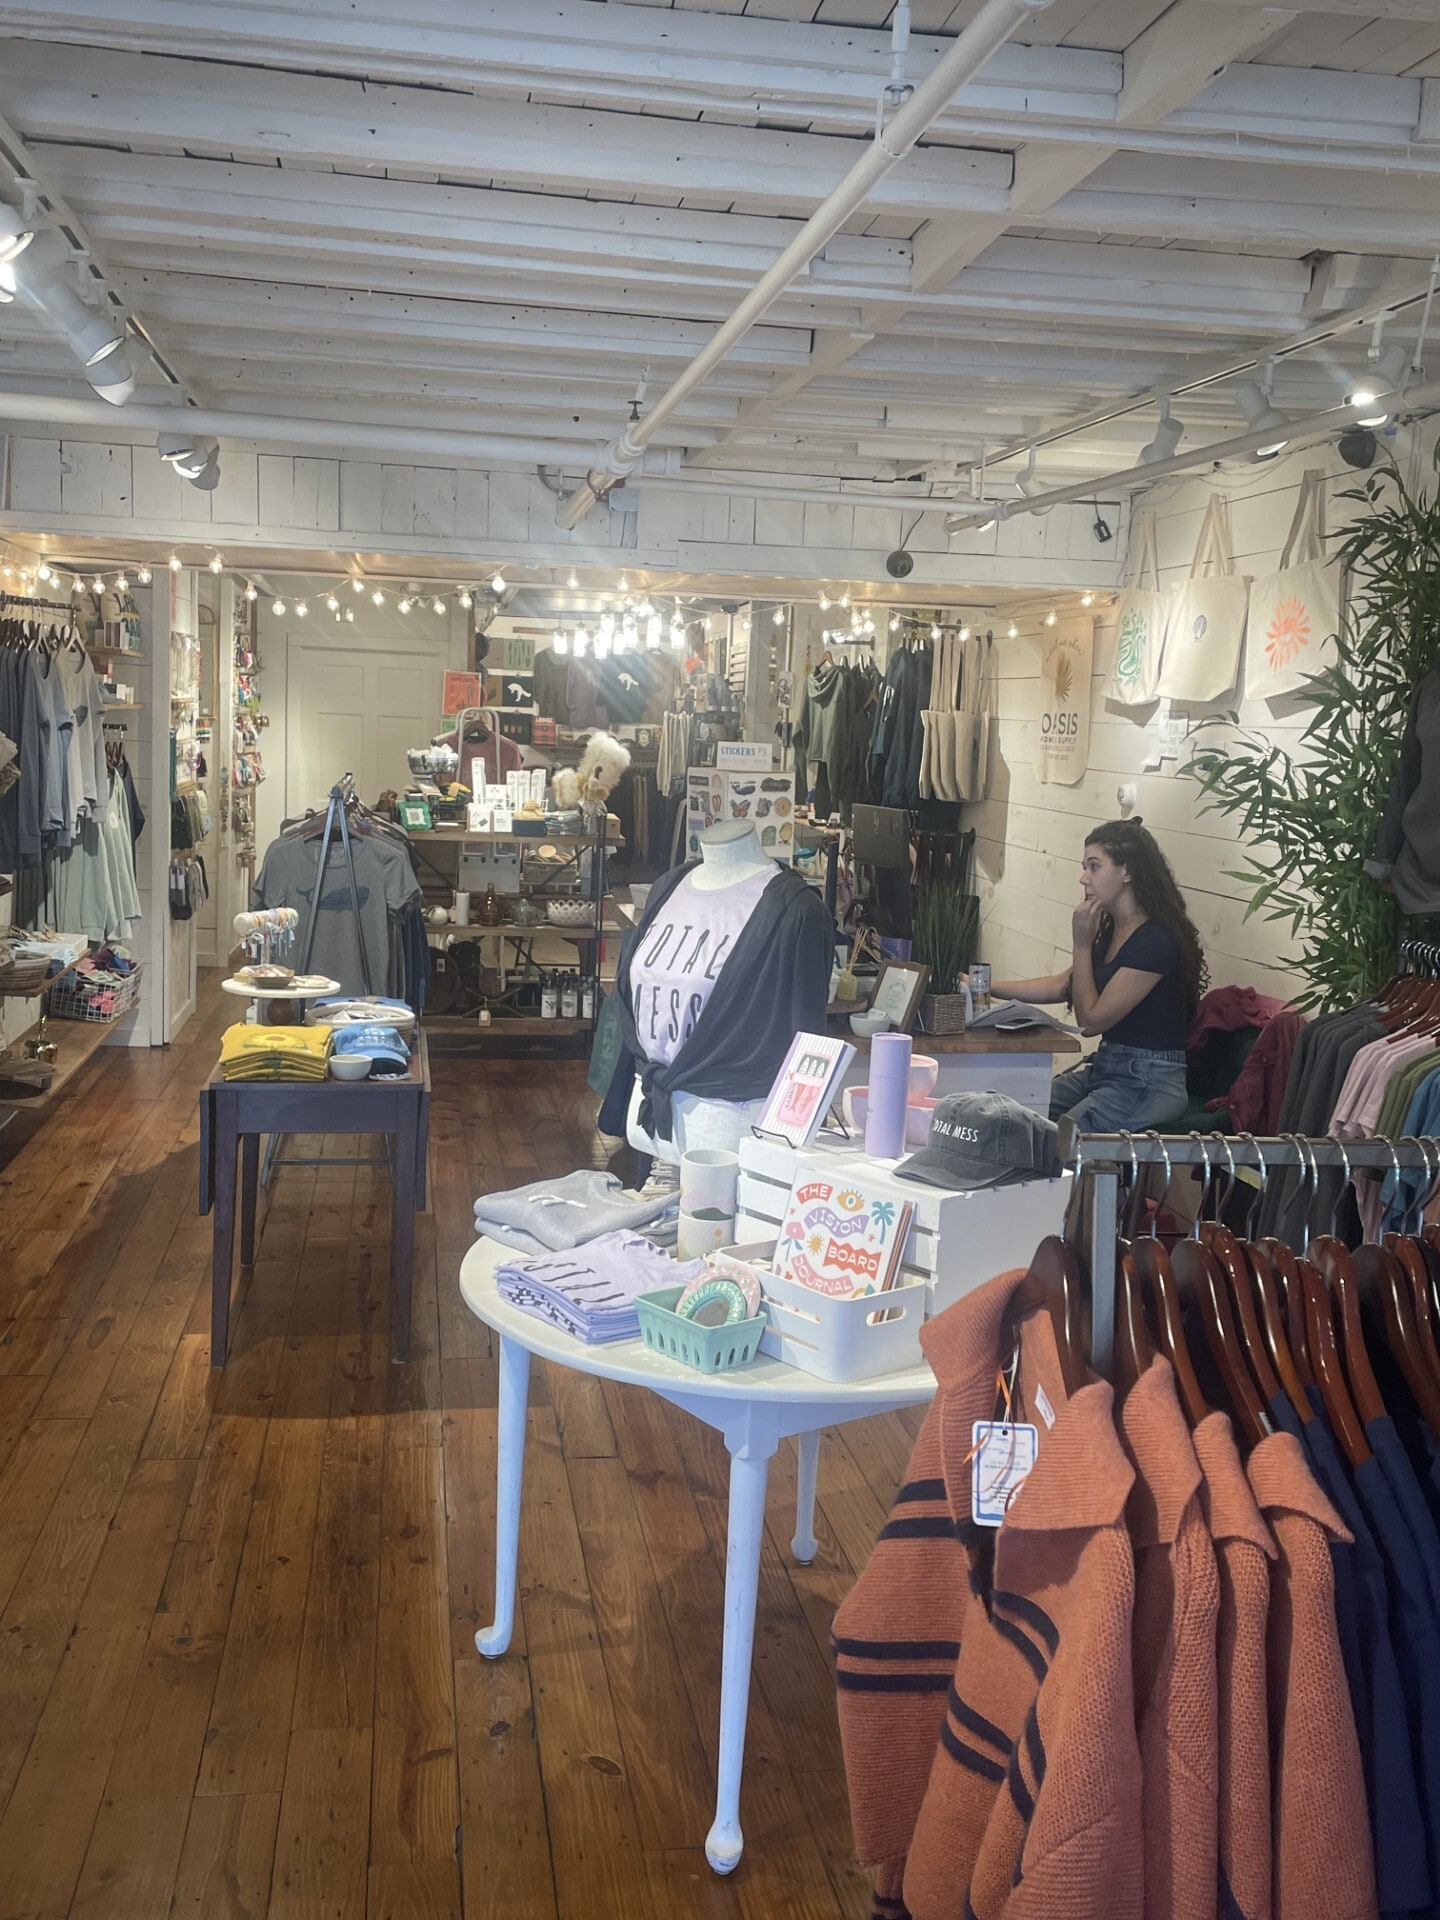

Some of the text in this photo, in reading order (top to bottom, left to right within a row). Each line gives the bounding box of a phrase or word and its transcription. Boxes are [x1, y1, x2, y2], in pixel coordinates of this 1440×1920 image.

[1041, 712, 1078, 735] OASIS
[720, 746, 756, 756] STICKERS
[951, 1125, 980, 1143] MESS
[800, 1185, 829, 1200] THE
[809, 1209, 862, 1234] VISION
[828, 1246, 878, 1271] BOARD
[794, 1256, 852, 1293] JOURNAL
